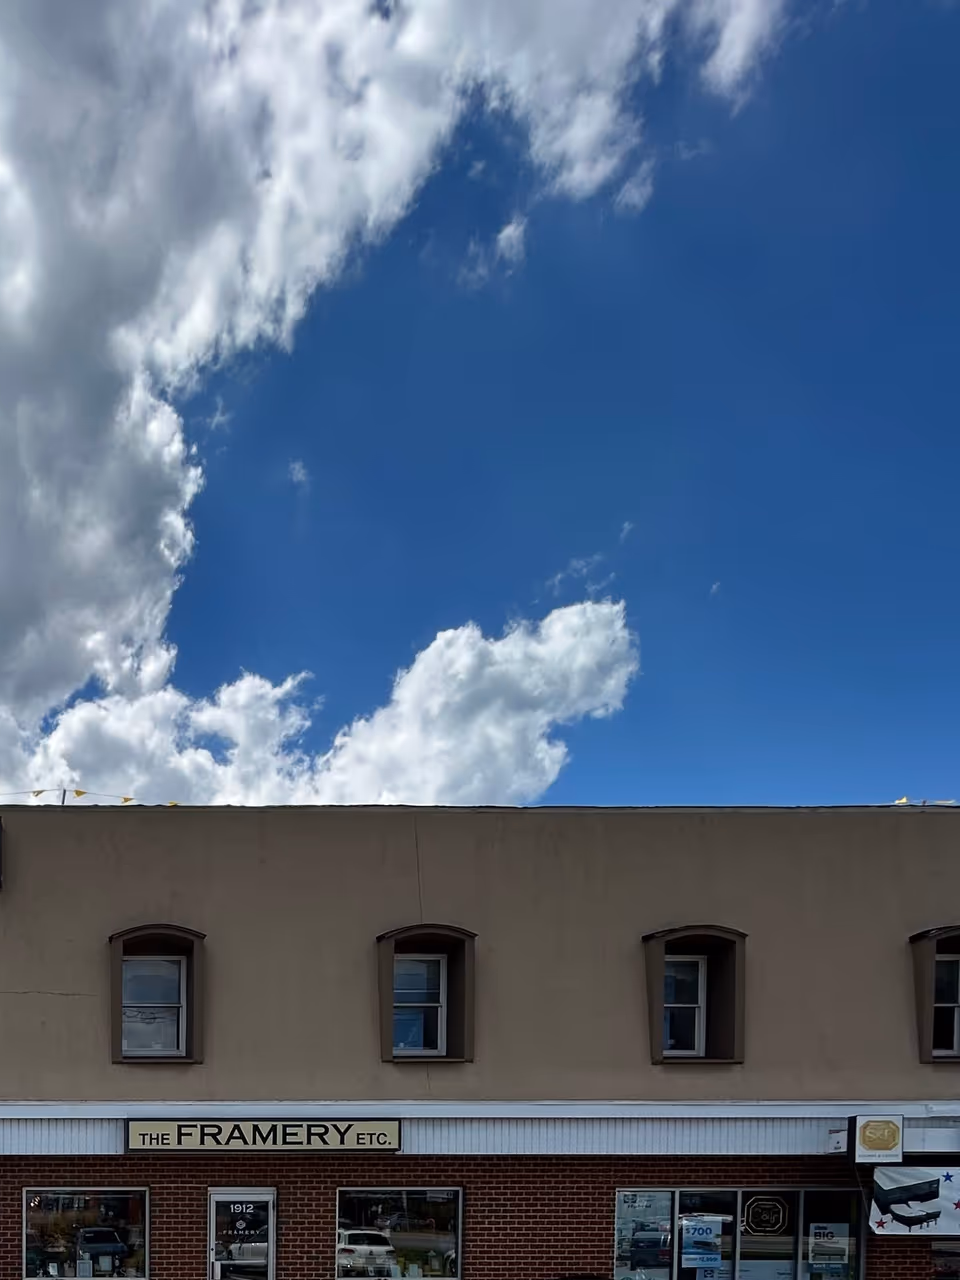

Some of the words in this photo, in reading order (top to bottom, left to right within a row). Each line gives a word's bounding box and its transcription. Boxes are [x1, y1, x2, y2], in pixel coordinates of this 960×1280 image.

[139, 1133, 171, 1145] THE
[177, 1124, 355, 1146] FRAMERY
[357, 1133, 392, 1146] ETC.
[230, 1204, 254, 1213] 1912
[685, 1227, 713, 1236] $700
[814, 1231, 836, 1241] BIG
